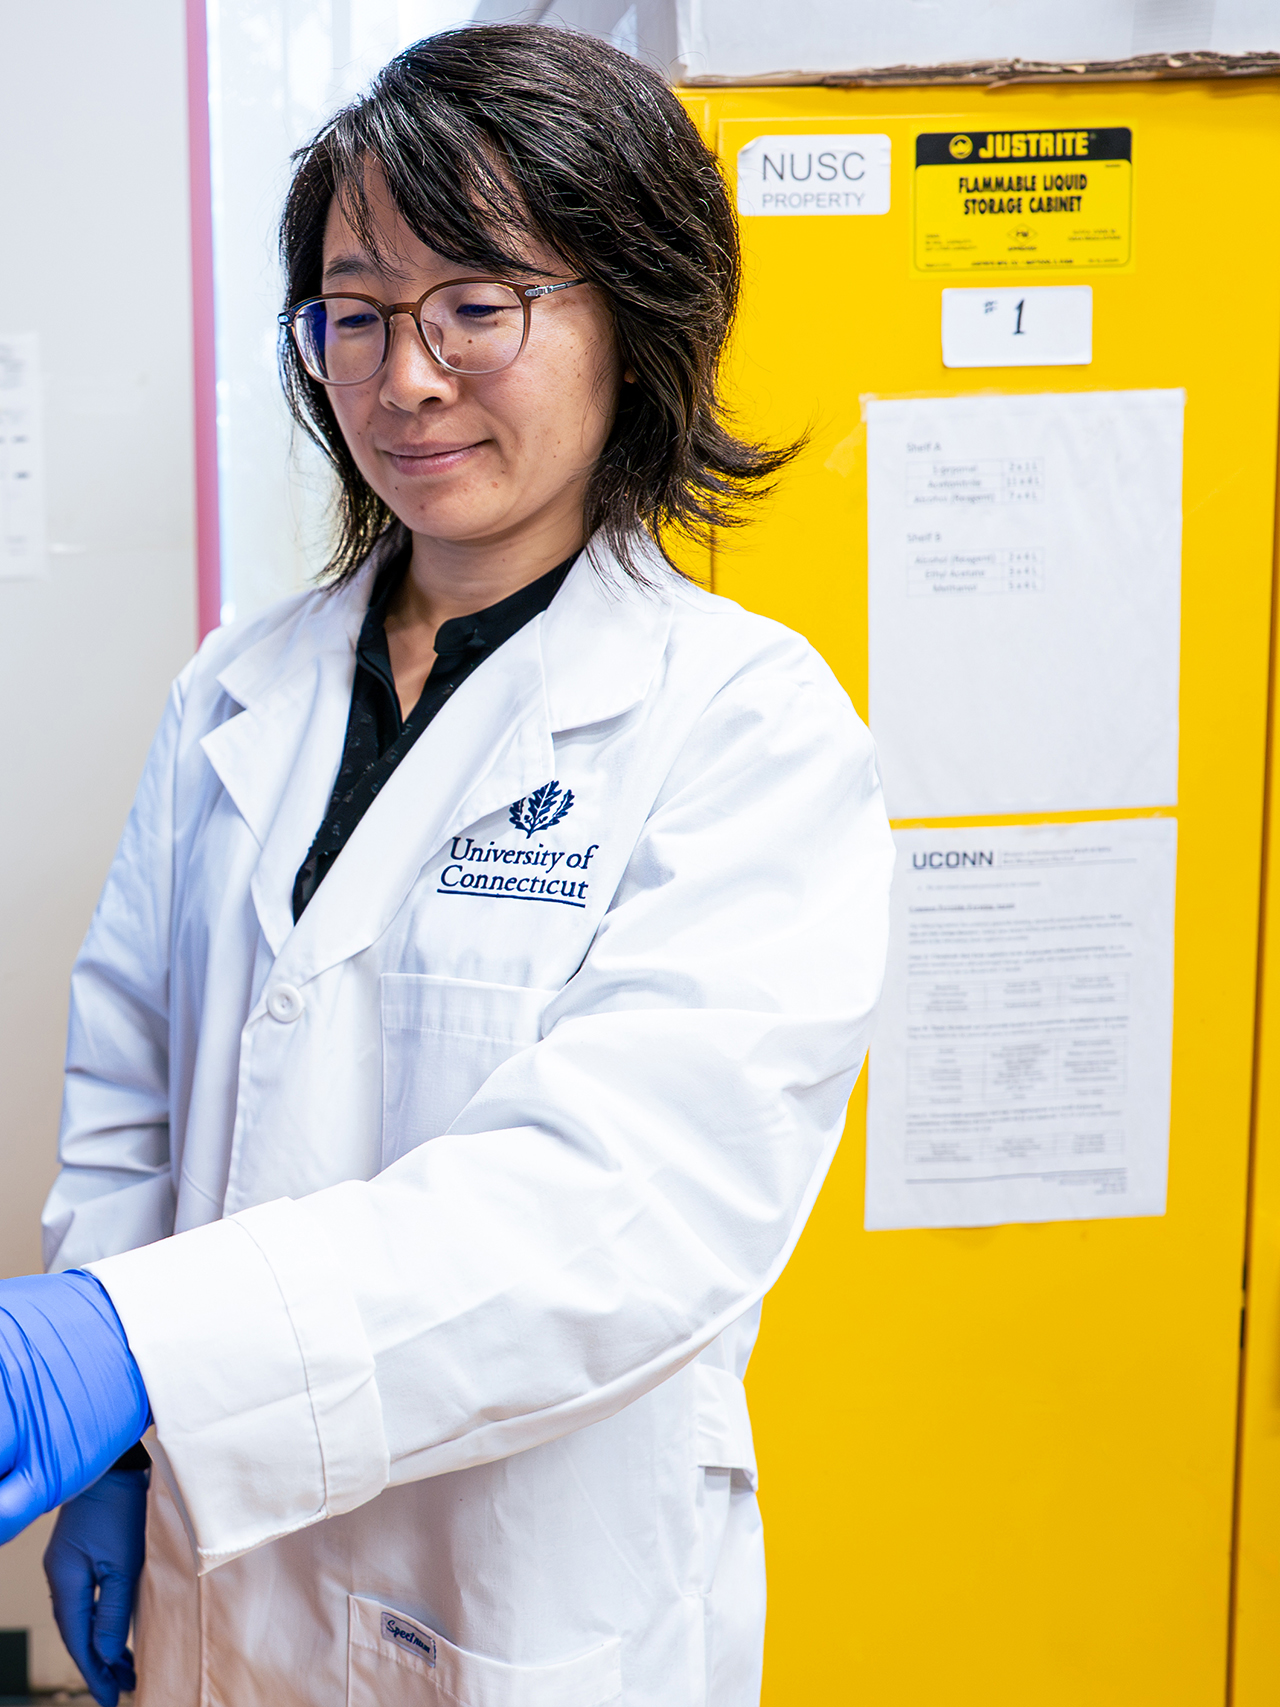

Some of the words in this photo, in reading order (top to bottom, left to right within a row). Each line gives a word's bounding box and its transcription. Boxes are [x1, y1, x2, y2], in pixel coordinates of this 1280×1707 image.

[978, 131, 1090, 159] JUSTRITE
[763, 151, 865, 181] NUSC
[959, 175, 1036, 193] FLAMMABLE
[1043, 174, 1088, 191] LIQUID
[762, 192, 866, 209] PROPERTY
[964, 197, 1023, 215] STORAGE
[1029, 195, 1083, 213] CABINET
[1012, 298, 1025, 335] 1
[450, 836, 566, 874] University
[566, 845, 600, 870] of
[912, 850, 995, 870] UCONN
[440, 864, 589, 899] Connecticut
[385, 1619, 431, 1654] Spectrum
